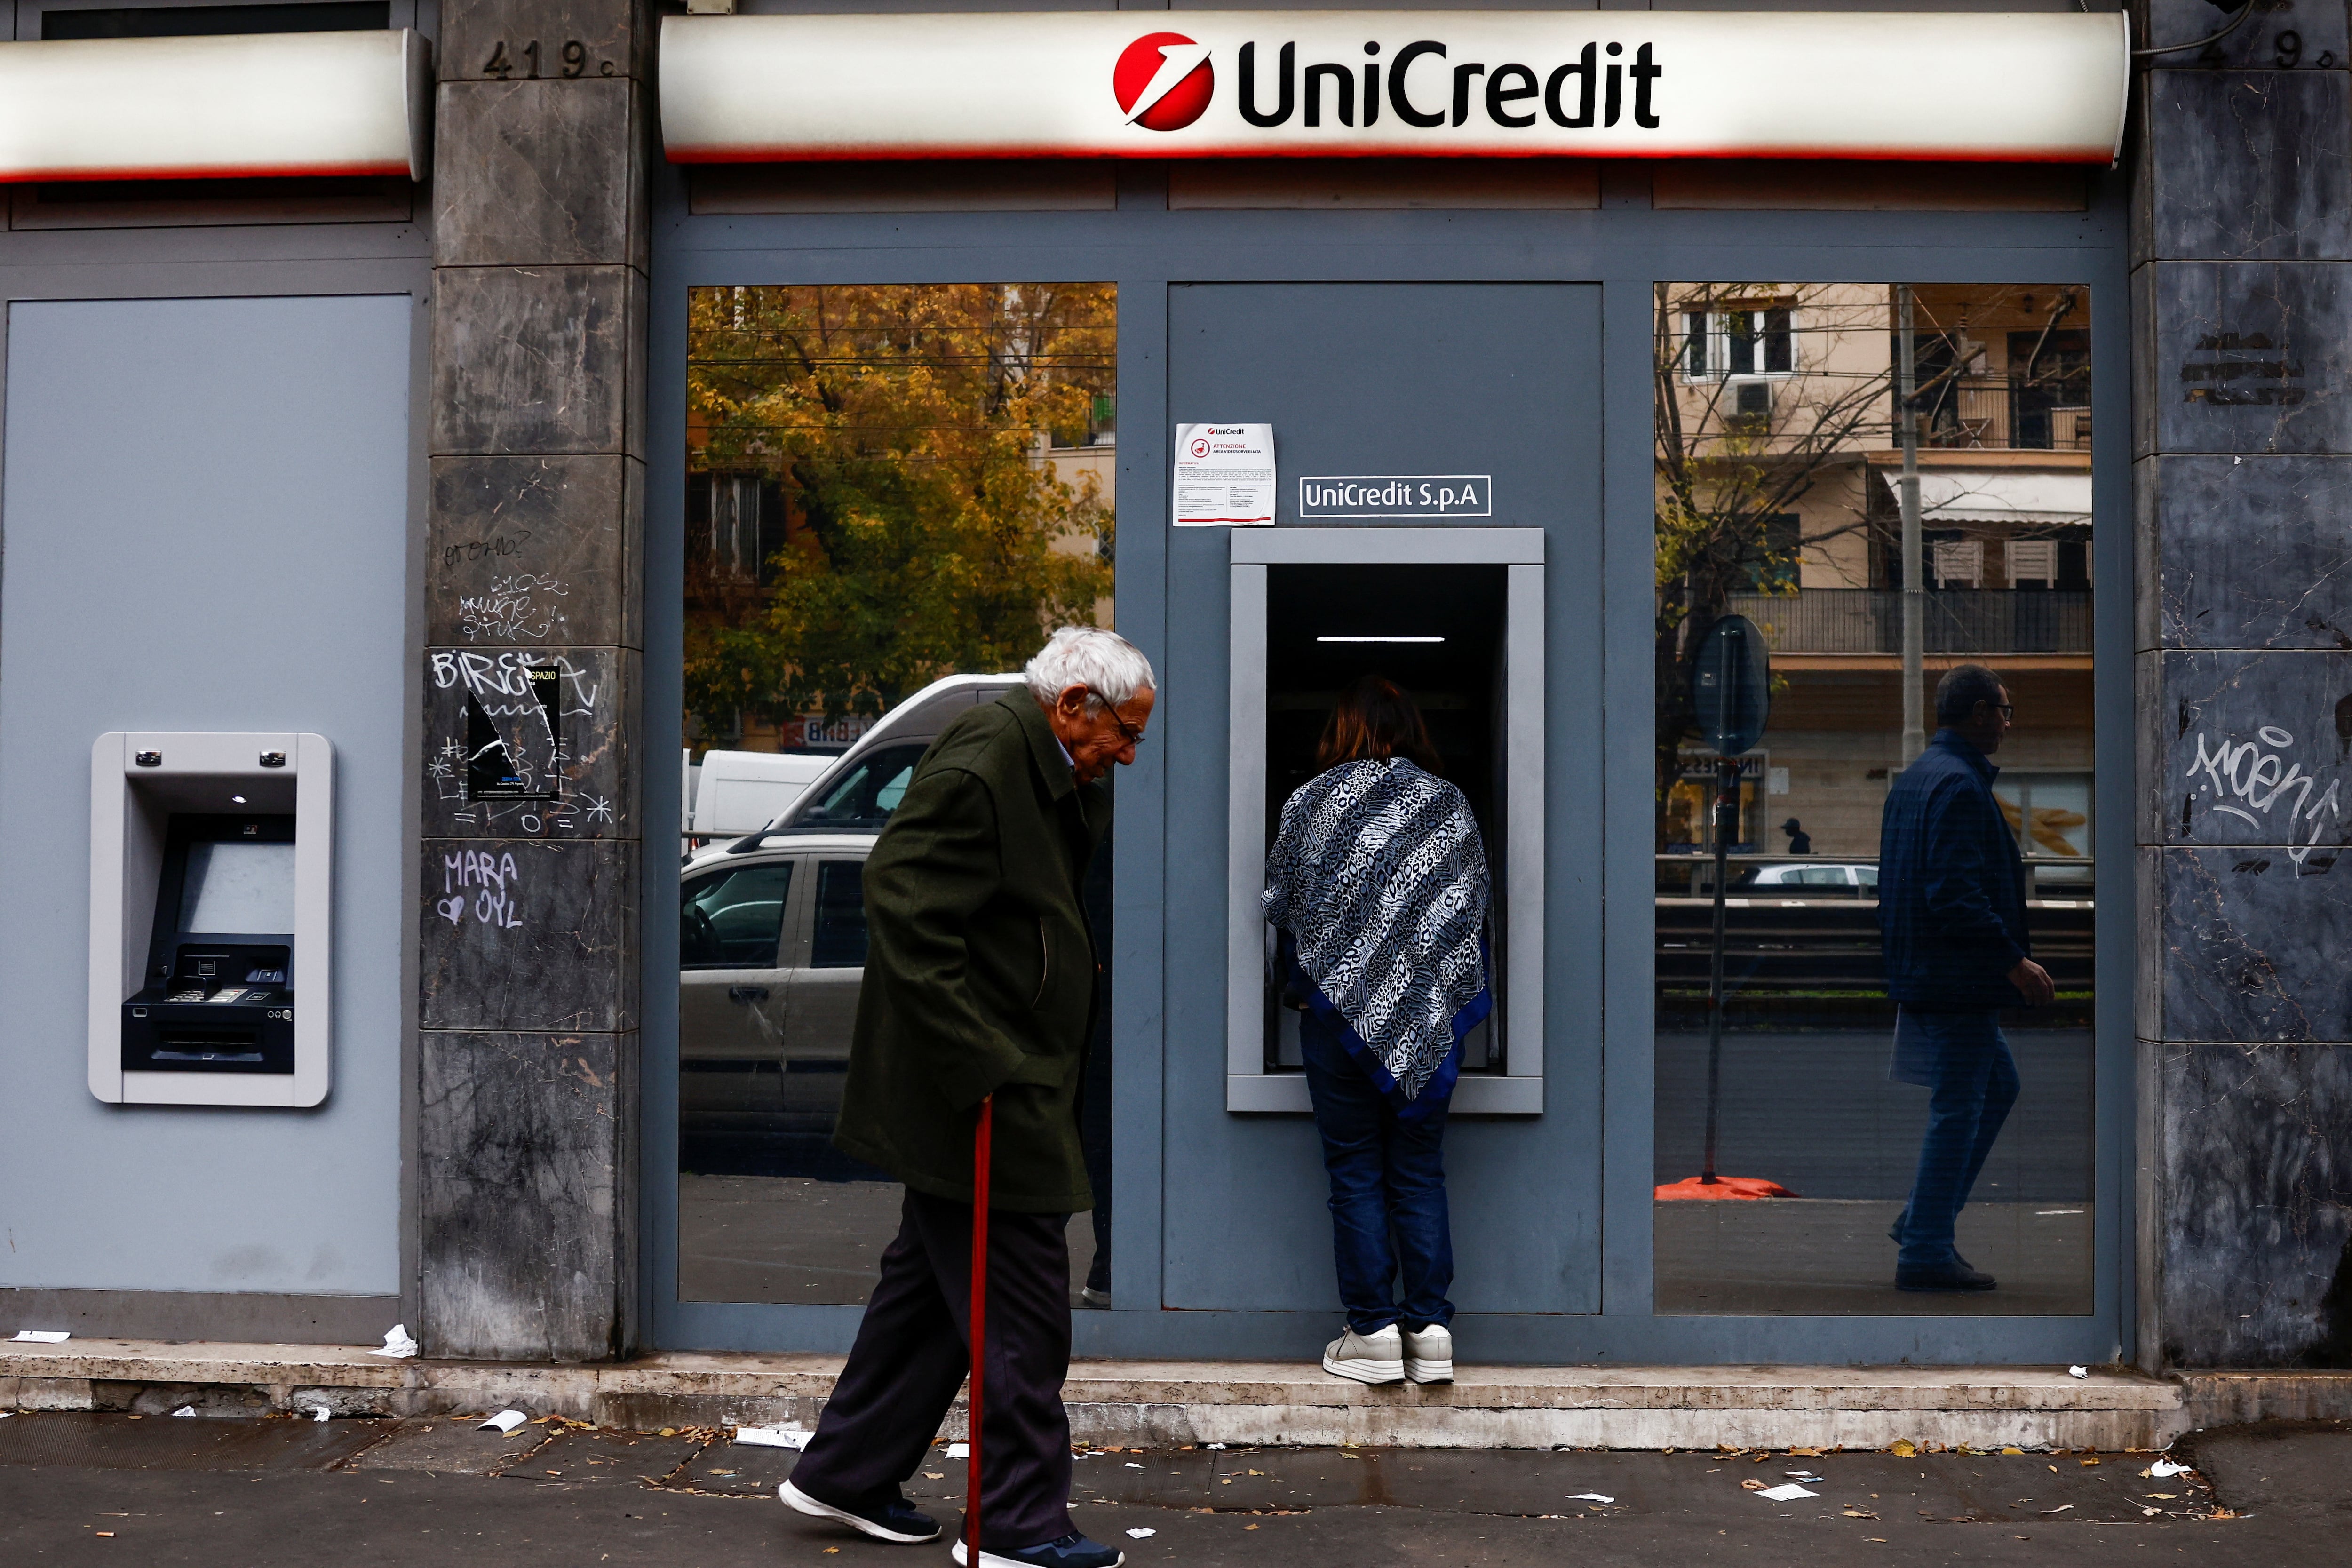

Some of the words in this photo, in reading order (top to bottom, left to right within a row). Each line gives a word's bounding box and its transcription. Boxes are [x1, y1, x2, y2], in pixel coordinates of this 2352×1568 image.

[1238, 40, 1662, 129] UniCredit
[1306, 481, 1413, 507] UniCredit
[1419, 483, 1478, 511] S.p.A
[532, 671, 556, 680] SPAZIO
[445, 850, 517, 893] MARA
